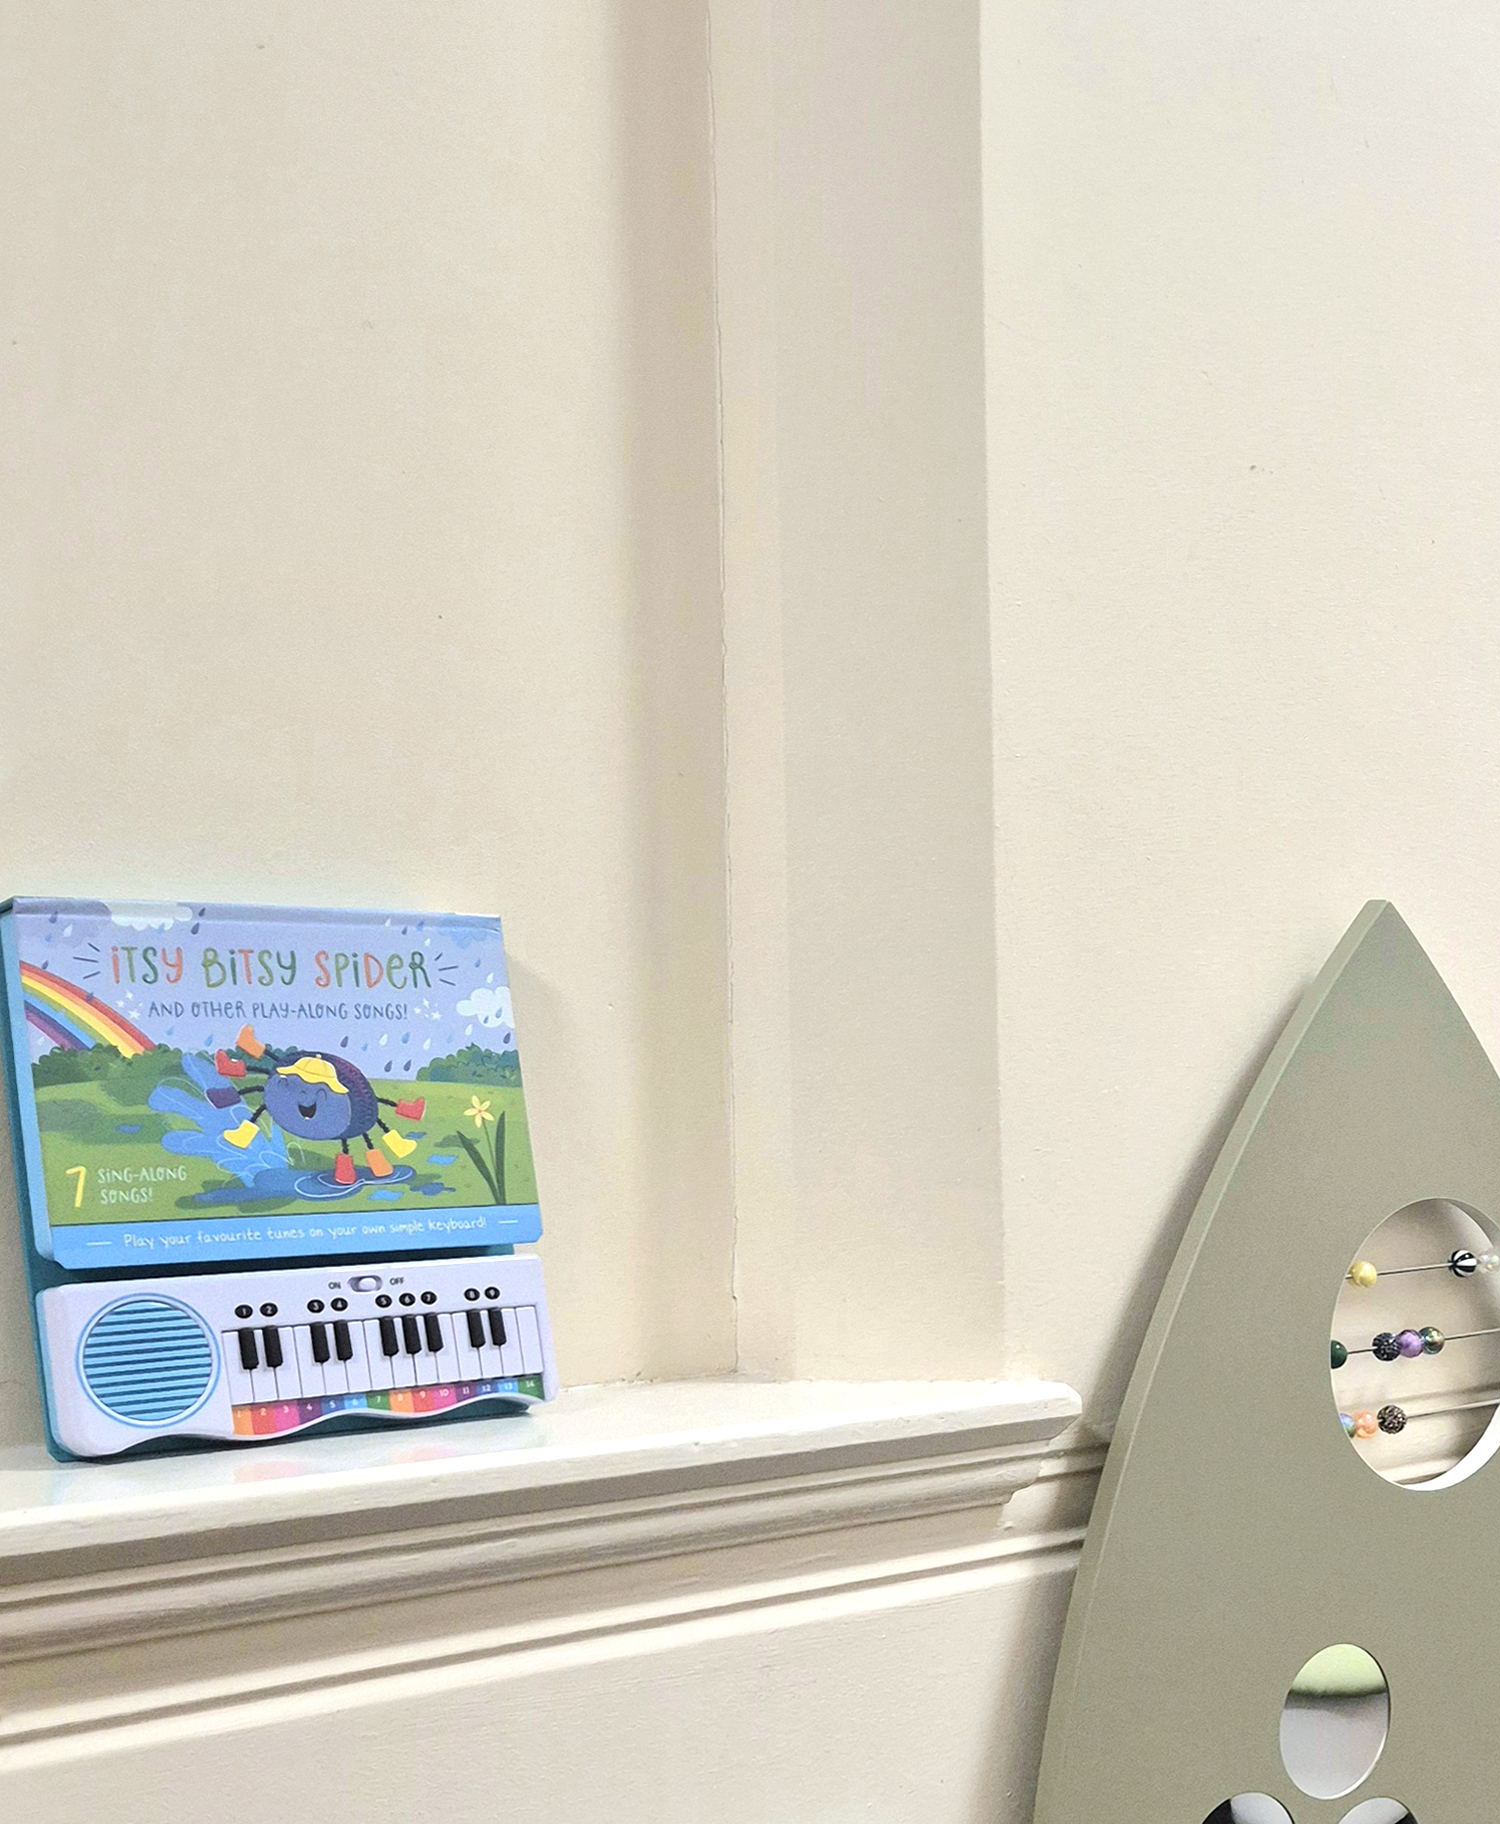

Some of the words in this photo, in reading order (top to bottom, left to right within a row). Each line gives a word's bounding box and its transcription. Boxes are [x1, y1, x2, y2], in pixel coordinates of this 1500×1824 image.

[148, 1001, 184, 1018] AND
[252, 1002, 348, 1020] PLAY-ALONG
[354, 1002, 408, 1020] SONGS!
[66, 1165, 86, 1208] 7
[101, 1187, 153, 1205] SONGS!
[123, 1233, 154, 1249] Play
[159, 1234, 191, 1248] your
[197, 1229, 262, 1244] favourite
[267, 1228, 305, 1240] tunes
[309, 1228, 323, 1238] on
[328, 1226, 356, 1239] your
[362, 1225, 386, 1235] own
[390, 1220, 424, 1236] simple
[428, 1215, 486, 1234] keyboard!
[328, 1281, 341, 1290] ON
[389, 1277, 404, 1286] OFF
[260, 1408, 266, 1416] 2
[283, 1405, 289, 1413] 3
[306, 1403, 313, 1411] 4
[330, 1401, 336, 1409] 5
[439, 1388, 449, 1397] 10
[482, 1384, 492, 1392] 12
[504, 1382, 513, 1390] 13
[525, 1380, 535, 1388] 14
